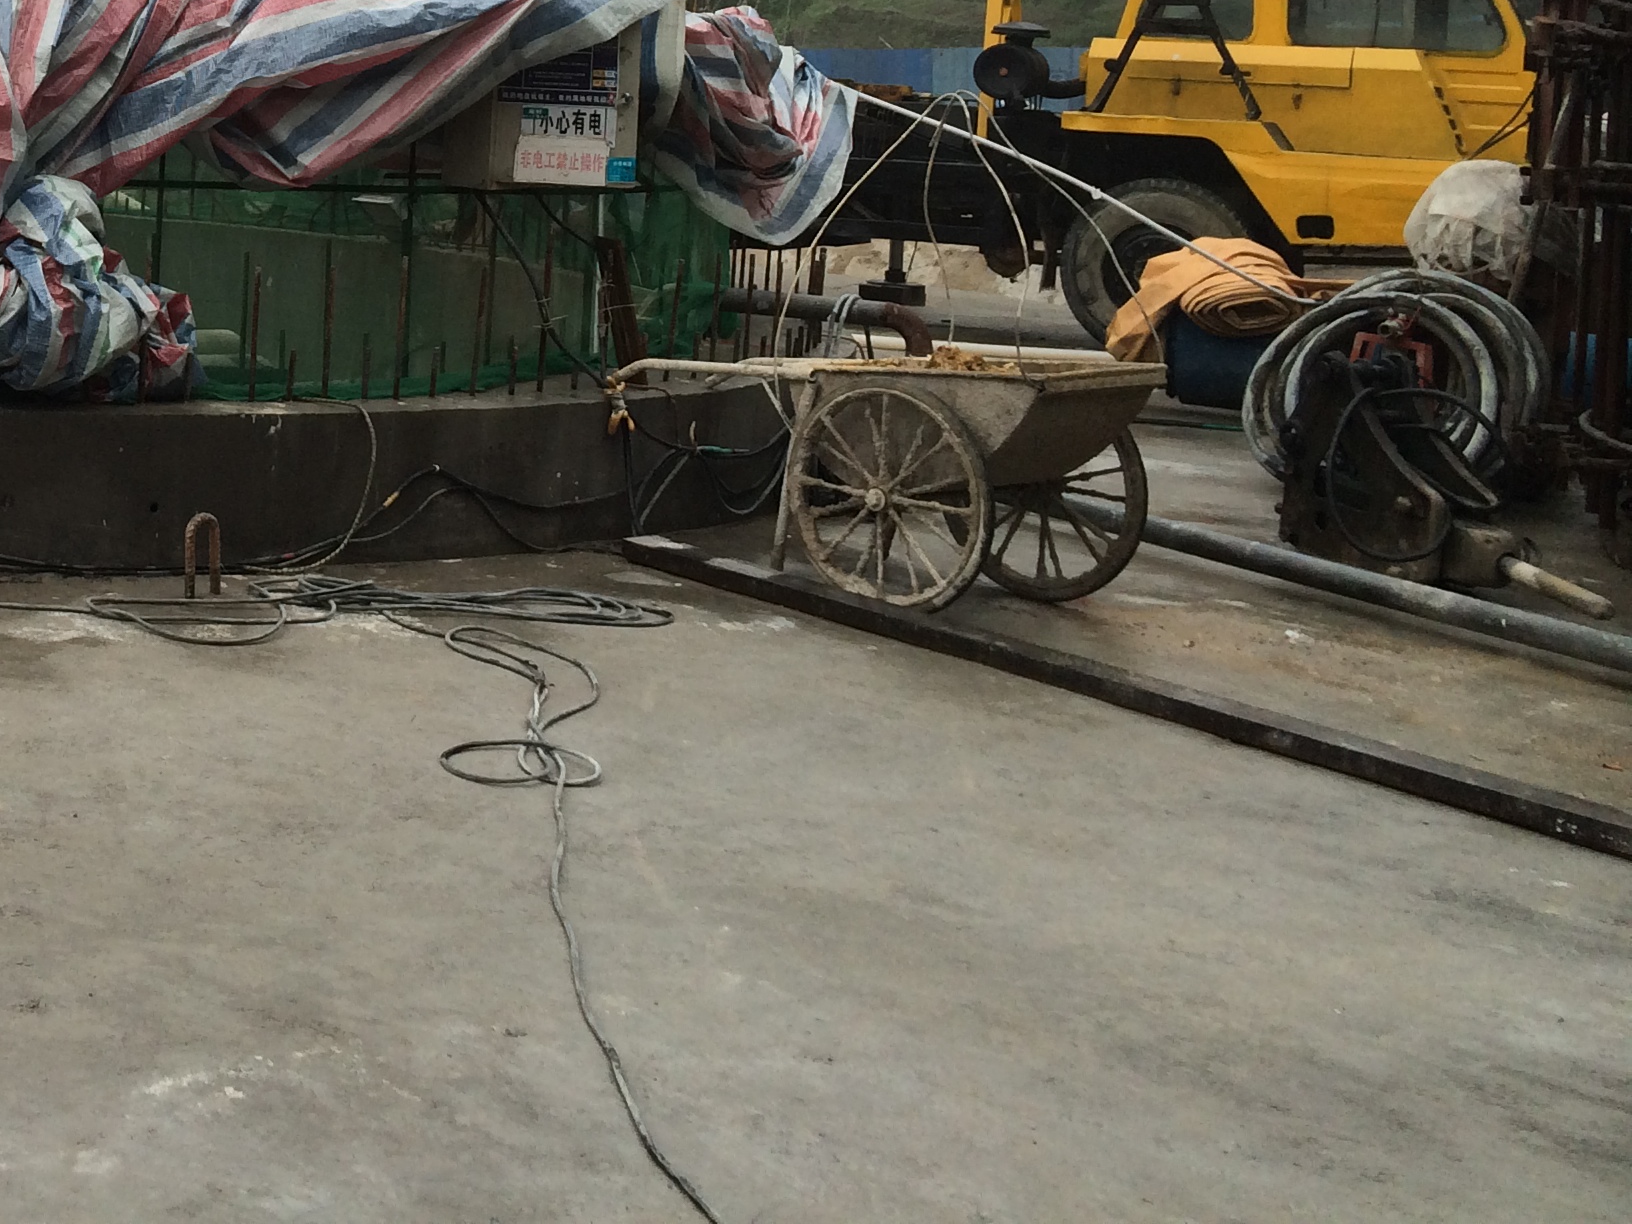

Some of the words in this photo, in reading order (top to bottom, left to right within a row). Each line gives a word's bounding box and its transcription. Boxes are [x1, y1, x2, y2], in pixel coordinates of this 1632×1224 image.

[539, 109, 602, 135] 小心有电
[520, 149, 605, 173] 非电工禁止操作
